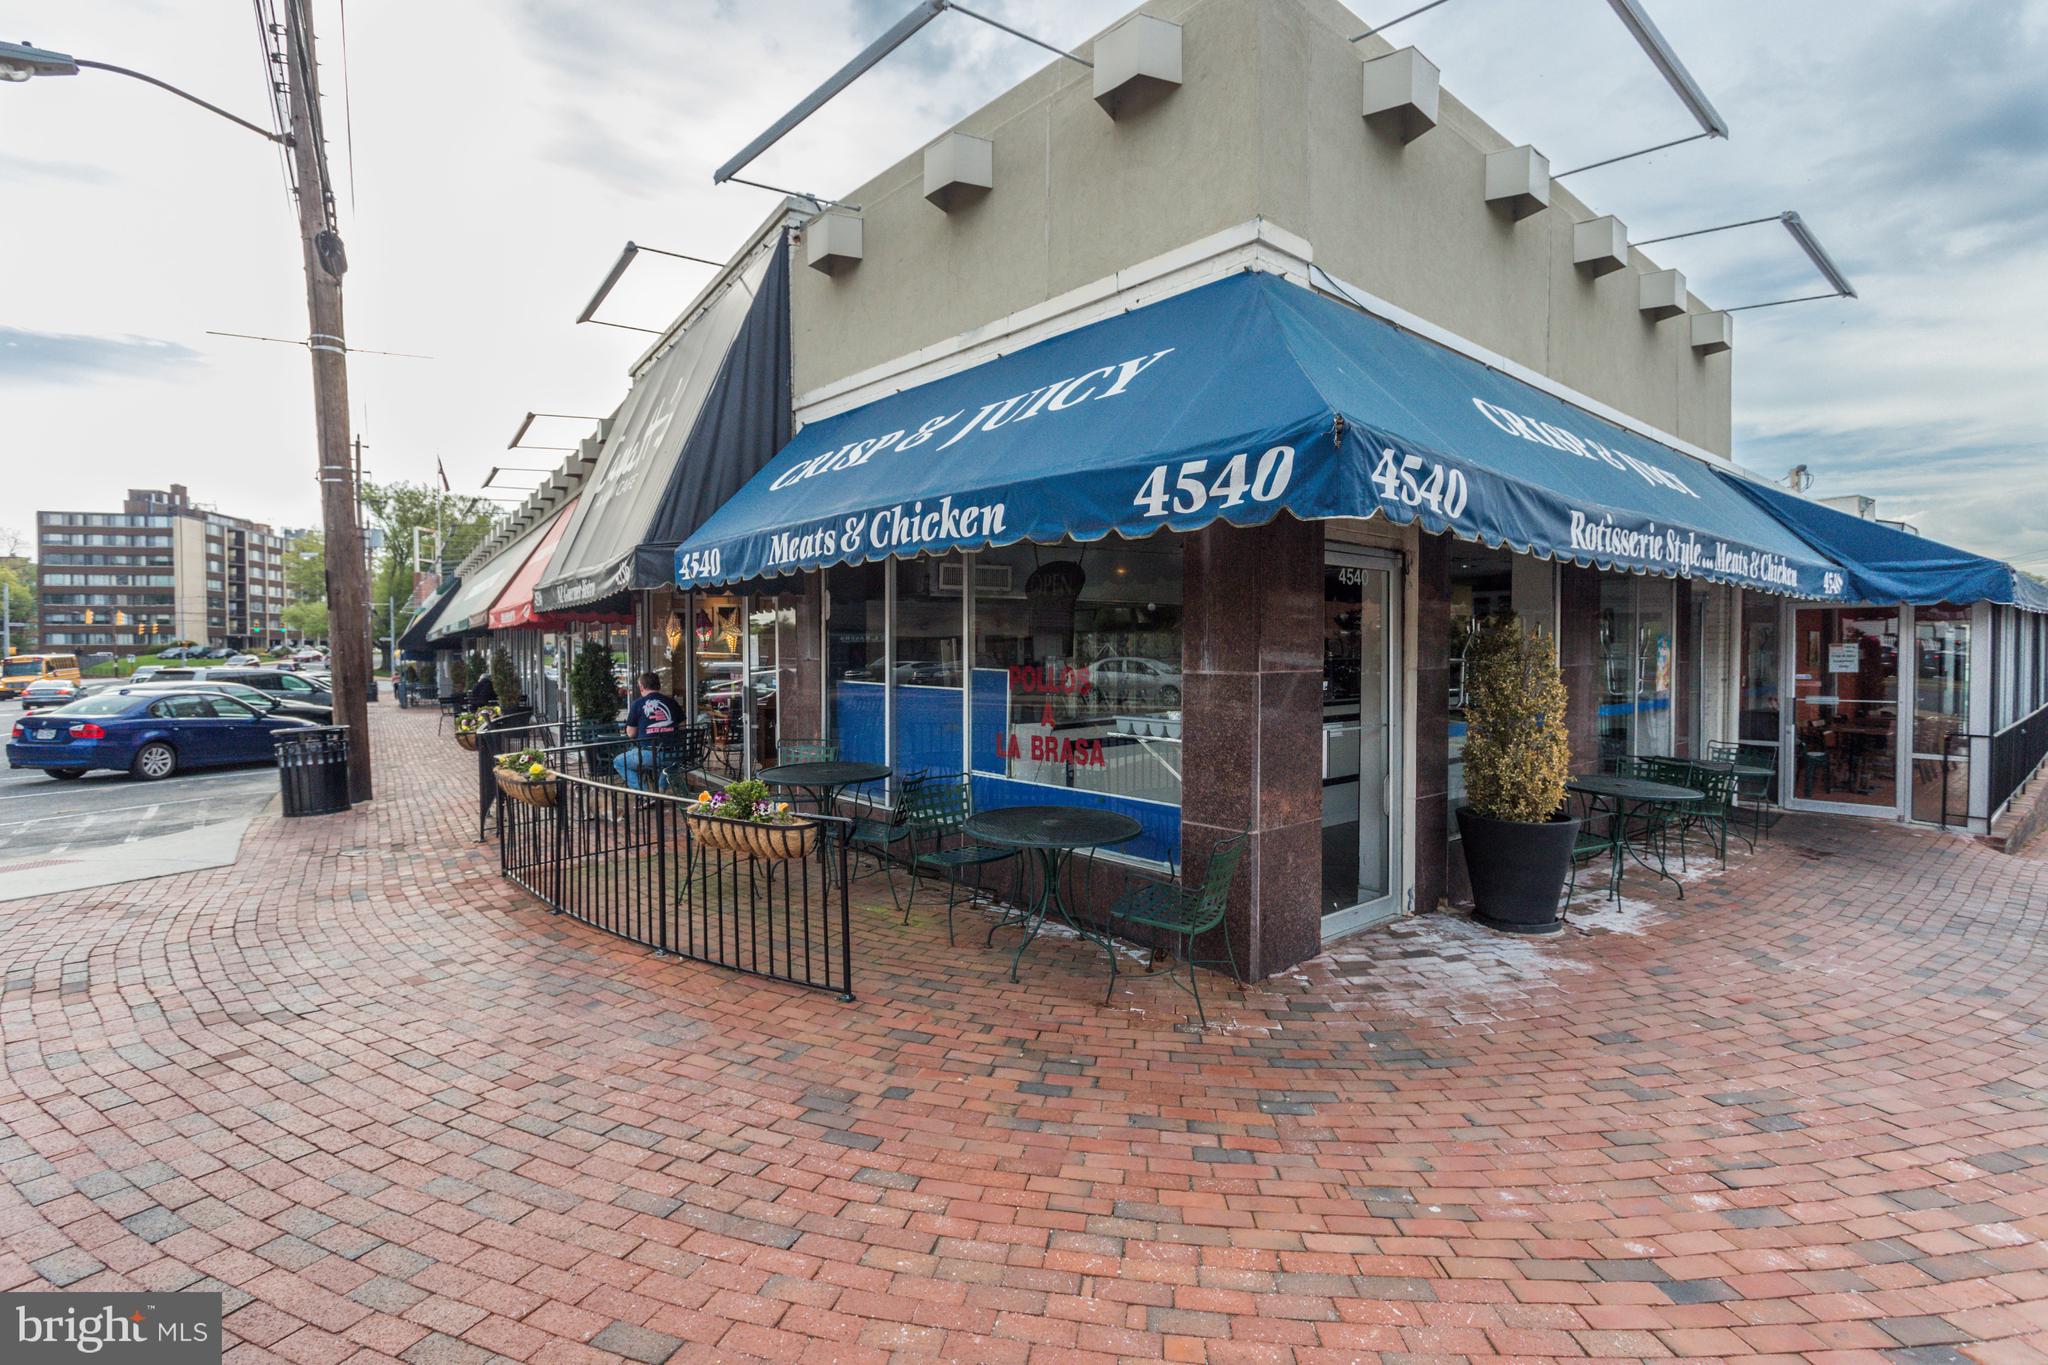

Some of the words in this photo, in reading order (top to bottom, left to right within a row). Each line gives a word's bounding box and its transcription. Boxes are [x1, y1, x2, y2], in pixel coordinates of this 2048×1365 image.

[768, 428, 907, 491] CRISP
[895, 409, 965, 452] &
[936, 348, 1175, 452] JUICY
[1472, 397, 1600, 461] CRISP
[1133, 446, 1295, 517] 4540
[1371, 448, 1468, 519] 4540
[767, 525, 836, 566] Meats
[840, 512, 867, 552] &
[870, 495, 1006, 549] Chicken
[1570, 510, 1664, 560] Rotisserie
[1714, 542, 1749, 577] Meats
[1750, 550, 1760, 579] &
[1760, 551, 1798, 588] Chicken
[678, 548, 721, 581] 4540
[1338, 567, 1369, 587] 4540
[1009, 664, 1092, 696] POLLOS
[1041, 703, 1056, 728] A
[996, 732, 1021, 760] LA
[1031, 734, 1106, 768] BRASA
